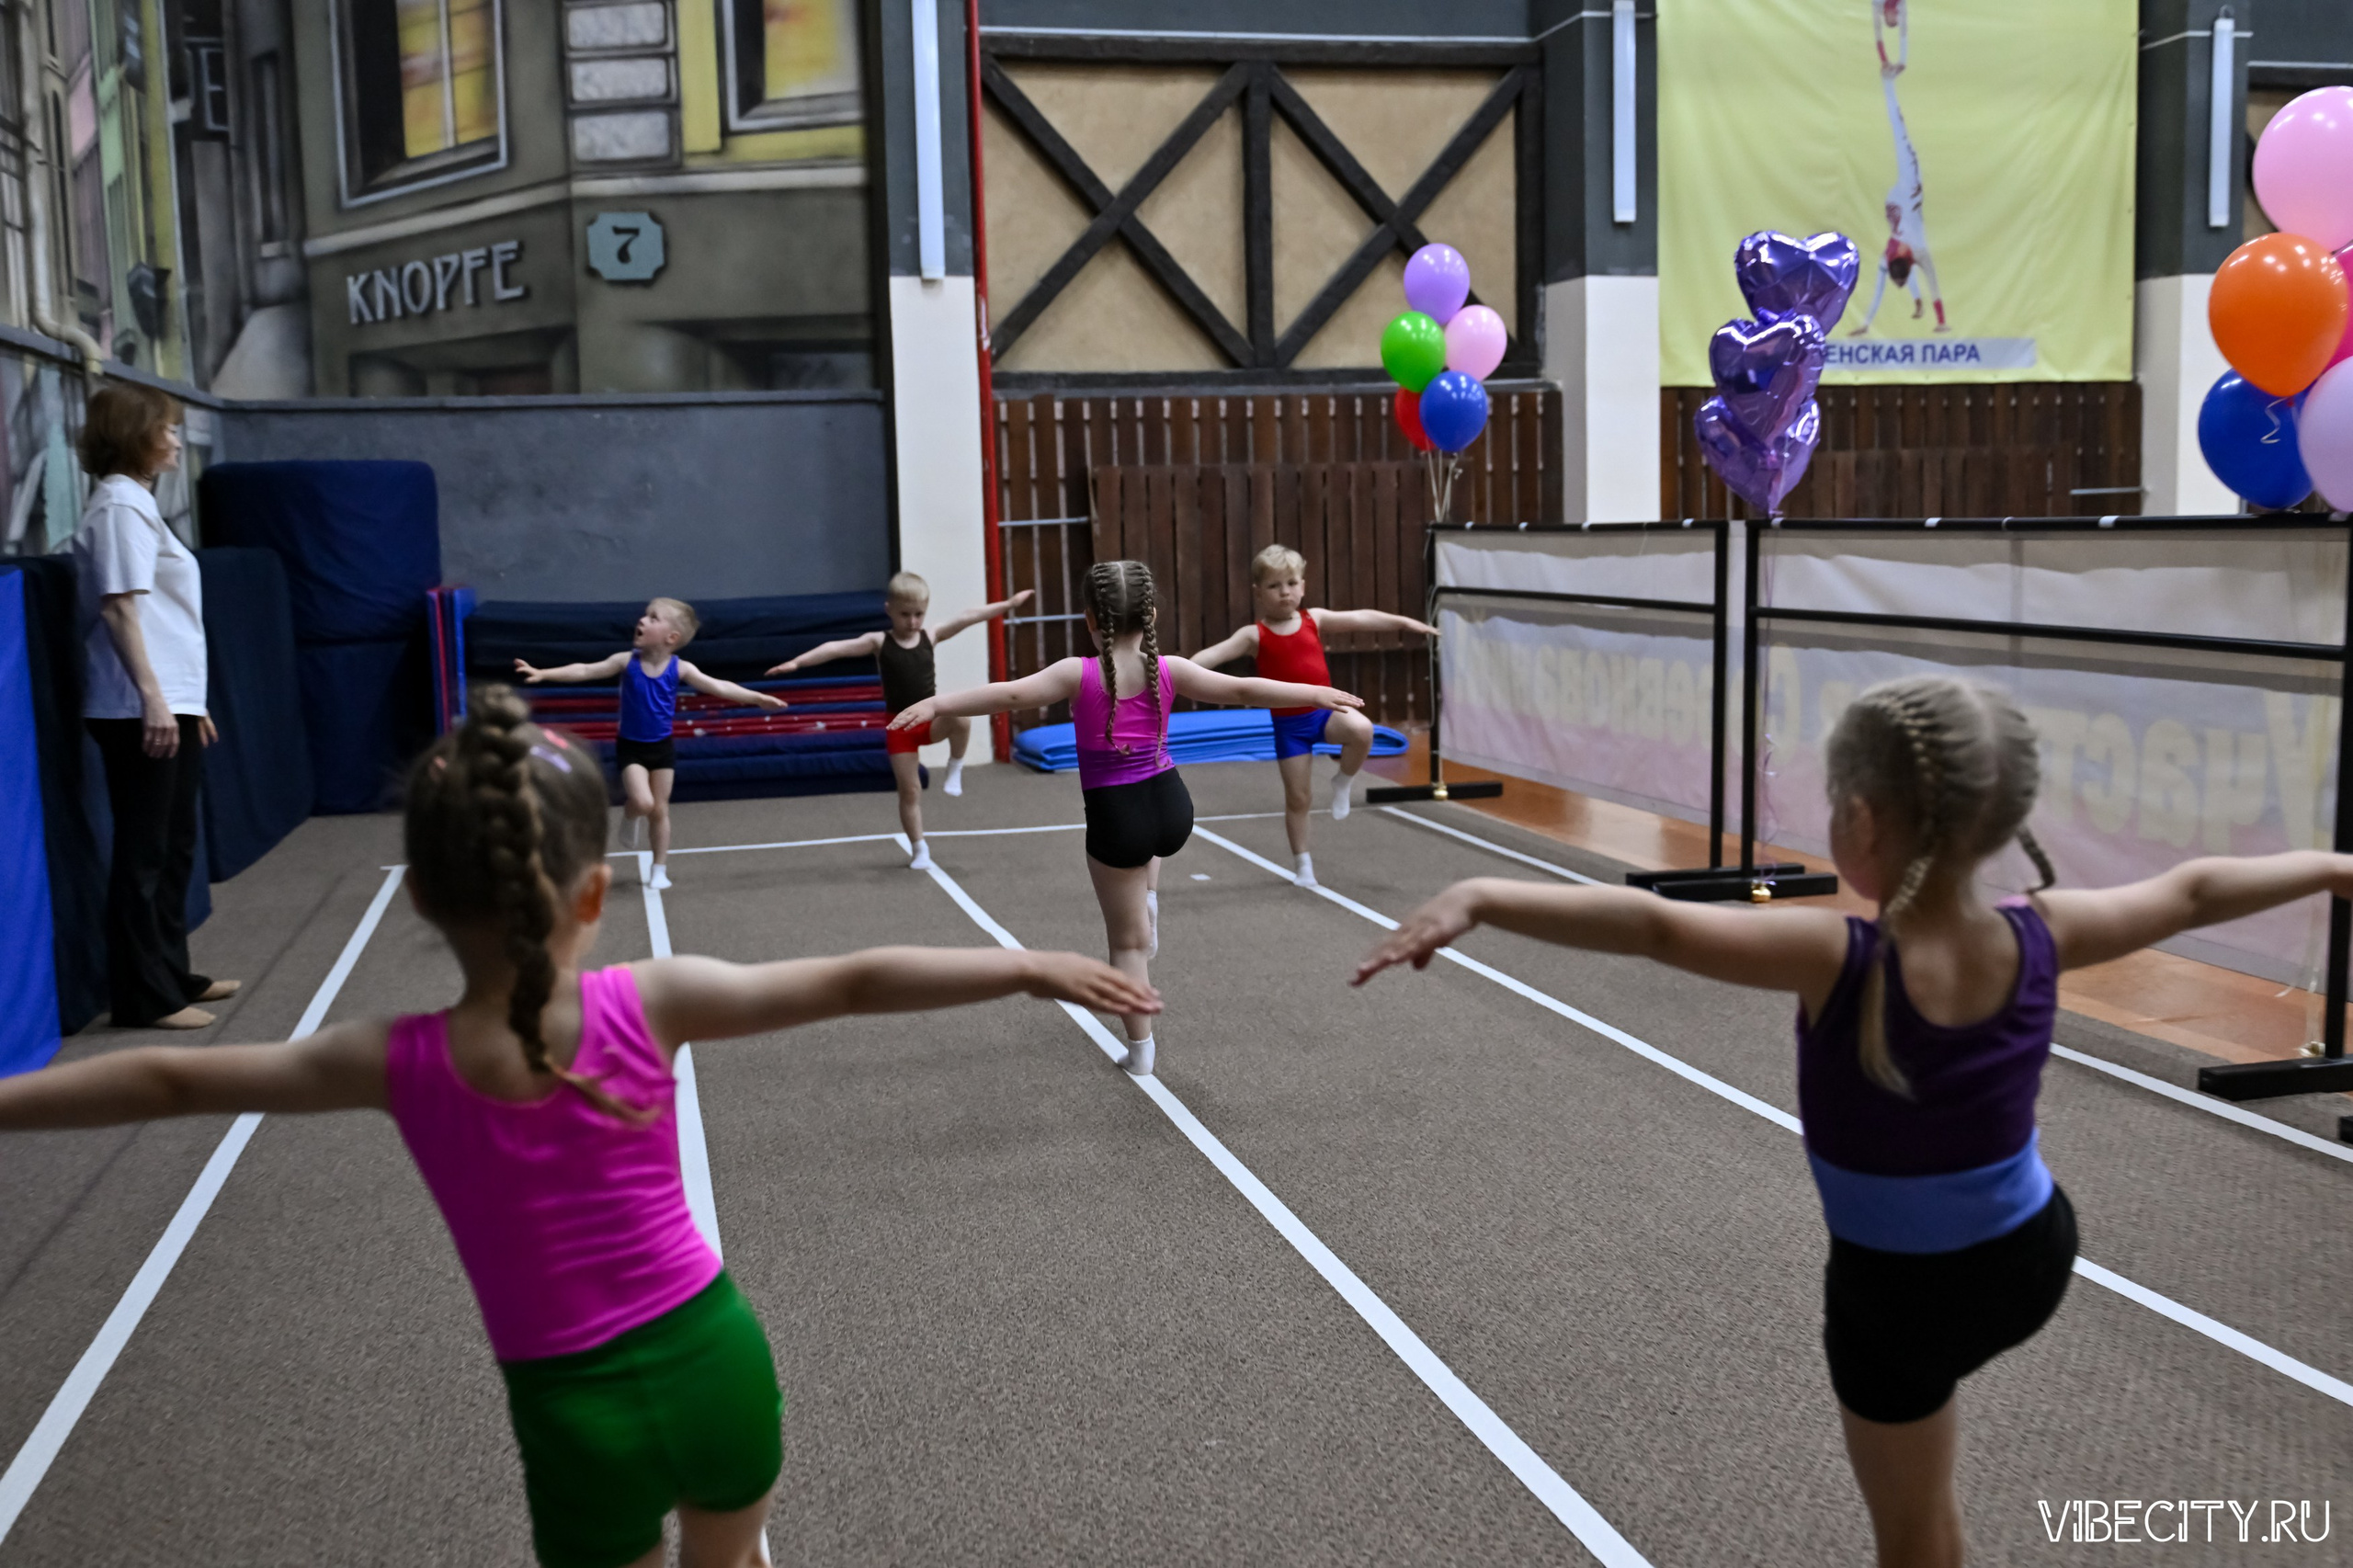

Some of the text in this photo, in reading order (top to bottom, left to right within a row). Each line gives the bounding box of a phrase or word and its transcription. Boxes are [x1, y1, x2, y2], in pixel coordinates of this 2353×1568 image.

[611, 225, 640, 264] 7
[347, 240, 525, 324] KNOPFE
[1821, 343, 1981, 364] ЕНСКАЯ ПАРА
